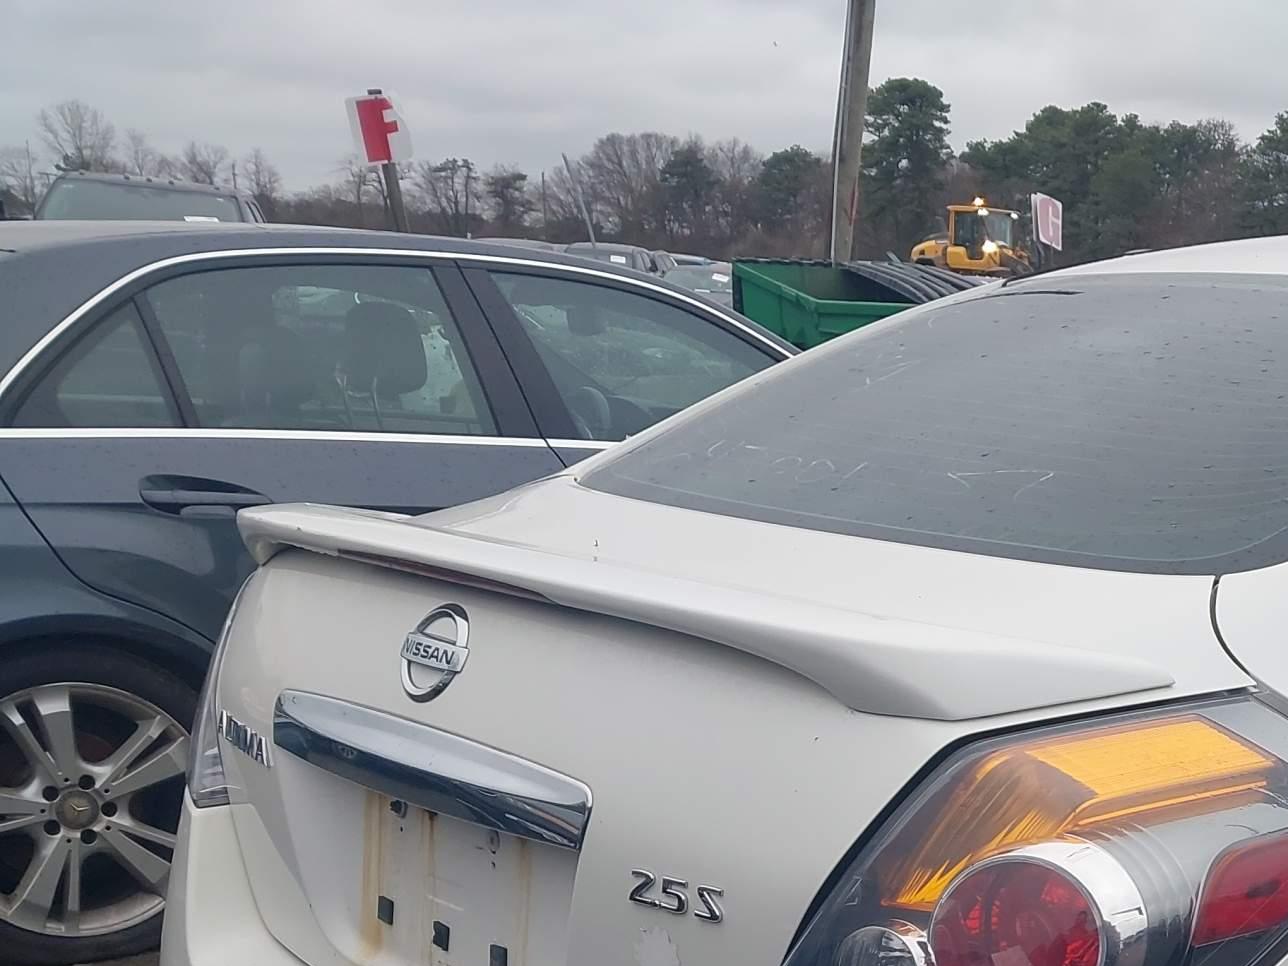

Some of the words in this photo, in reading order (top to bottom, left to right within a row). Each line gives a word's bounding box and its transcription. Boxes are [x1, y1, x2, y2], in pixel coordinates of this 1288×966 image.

[356, 98, 399, 162] F
[403, 637, 455, 665] NISSAN
[694, 884, 724, 922] S
